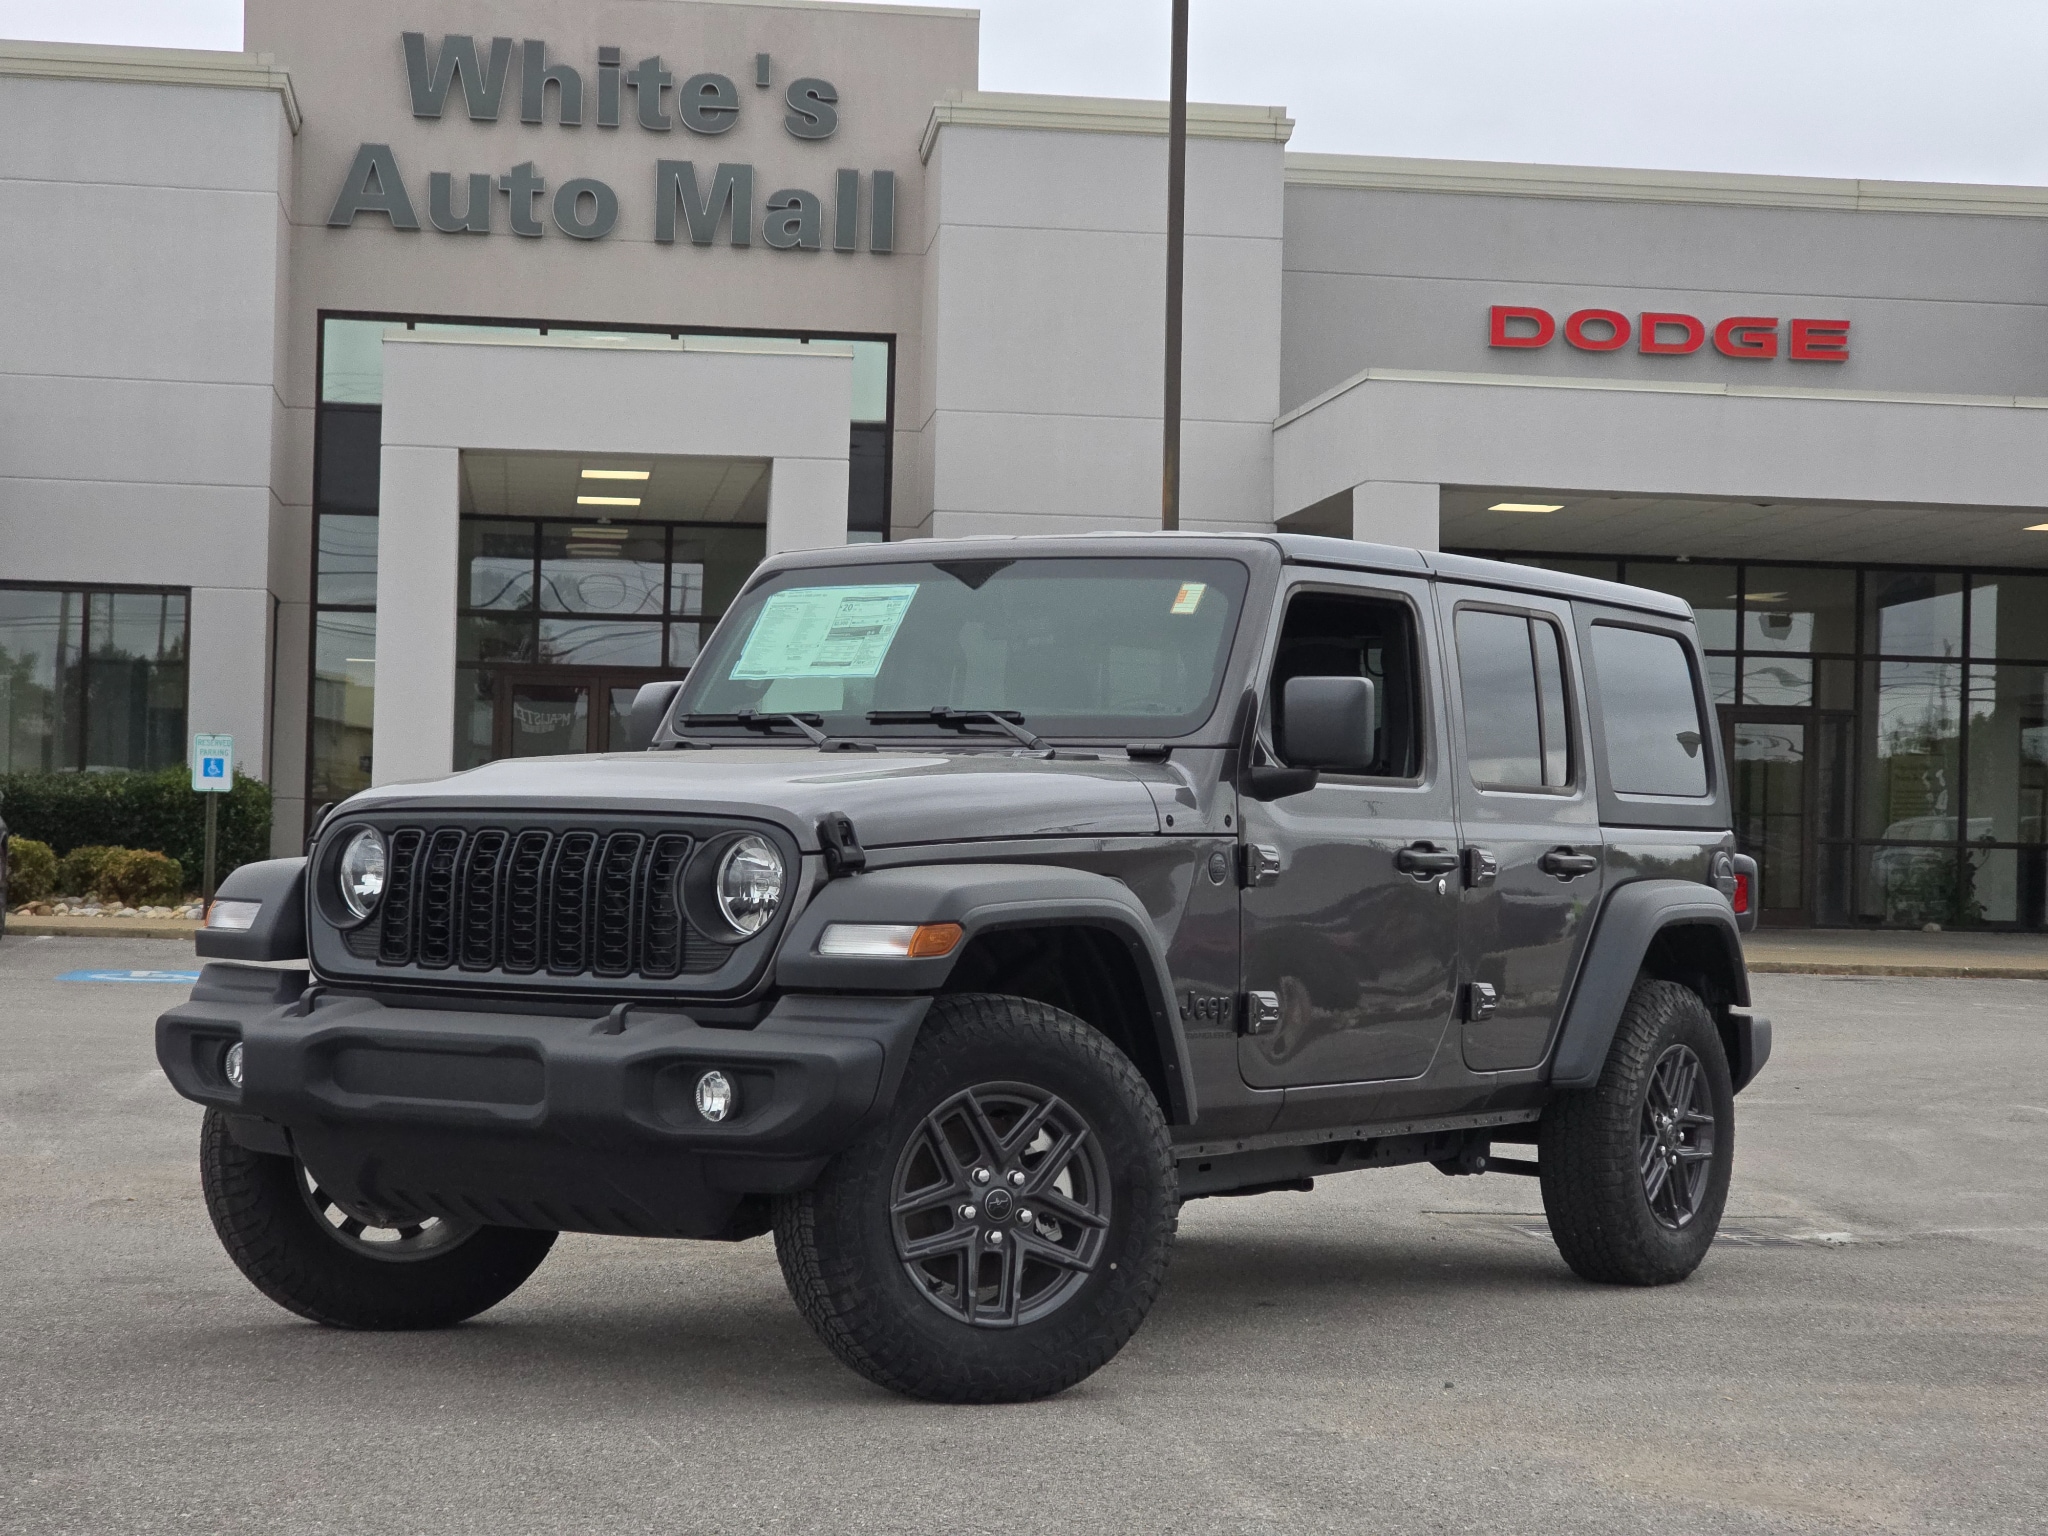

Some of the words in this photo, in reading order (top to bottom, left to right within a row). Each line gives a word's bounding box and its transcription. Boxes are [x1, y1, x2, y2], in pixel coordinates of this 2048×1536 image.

[402, 31, 839, 140] White's
[327, 143, 620, 241] Auto
[655, 158, 896, 253] Mall
[1488, 305, 1851, 362] DODGE
[197, 739, 232, 748] RESERVED
[200, 749, 230, 757] PARKING
[1179, 988, 1233, 1025] Jeep
